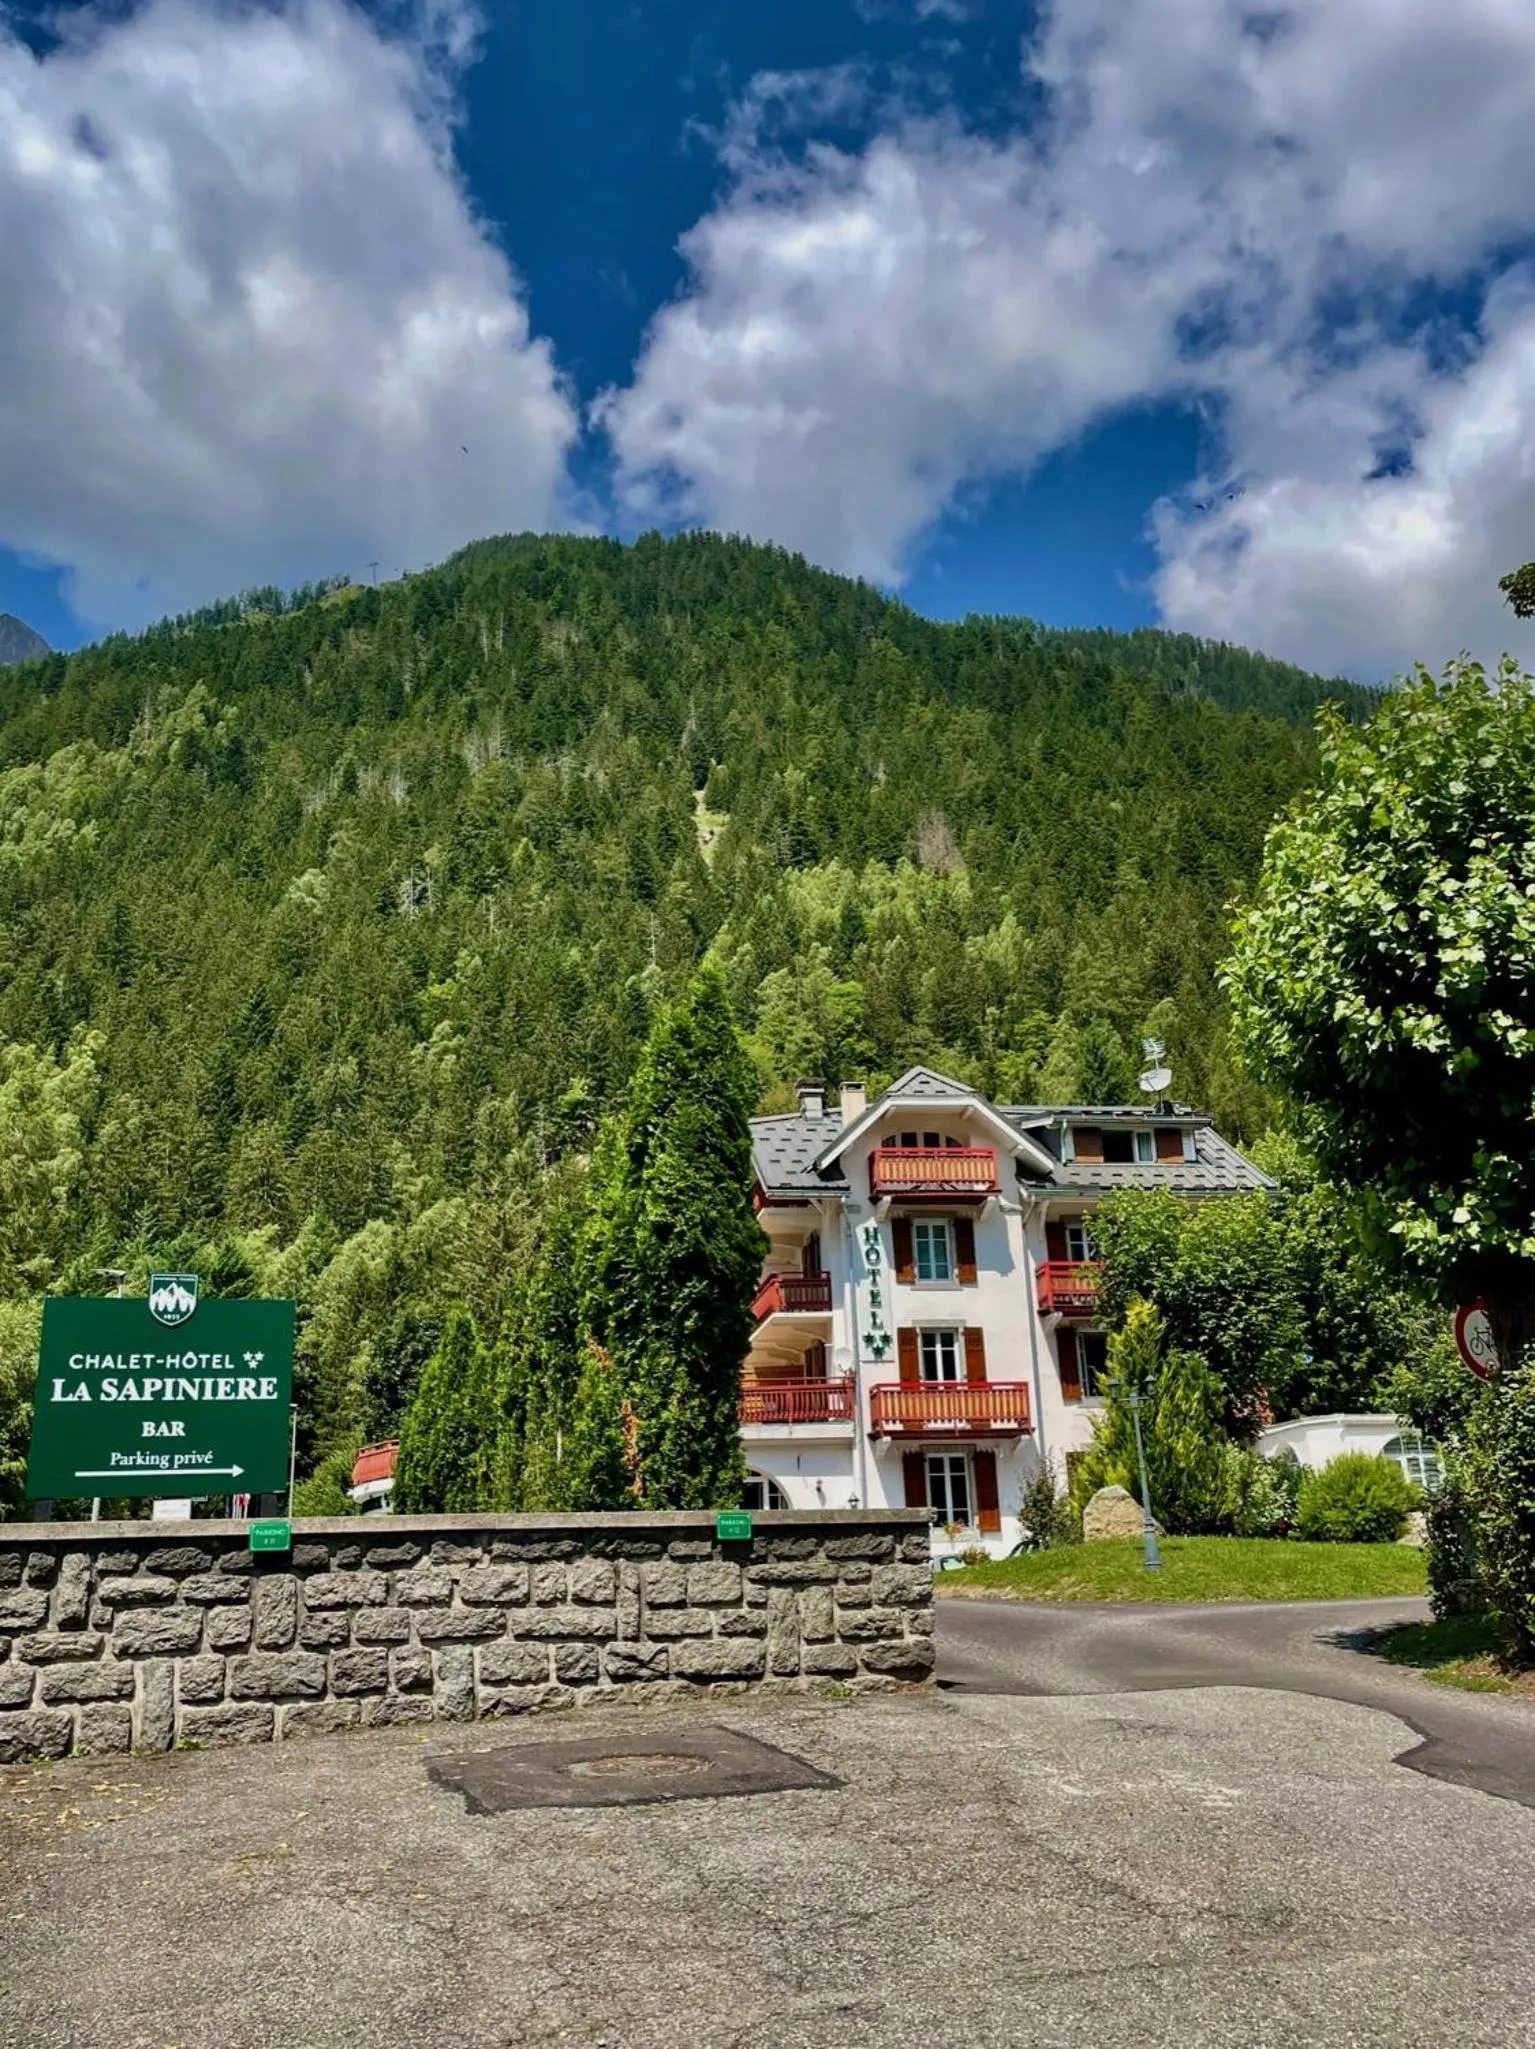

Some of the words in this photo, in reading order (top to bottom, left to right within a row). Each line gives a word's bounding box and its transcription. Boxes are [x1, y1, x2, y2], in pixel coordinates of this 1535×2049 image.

[68, 1351, 235, 1370] CHALET-HÔTEL
[50, 1379, 92, 1402] LA
[100, 1377, 278, 1402] SAPINIERE
[141, 1421, 186, 1437] BAR
[110, 1452, 170, 1469] Parking
[173, 1450, 213, 1469] privé
